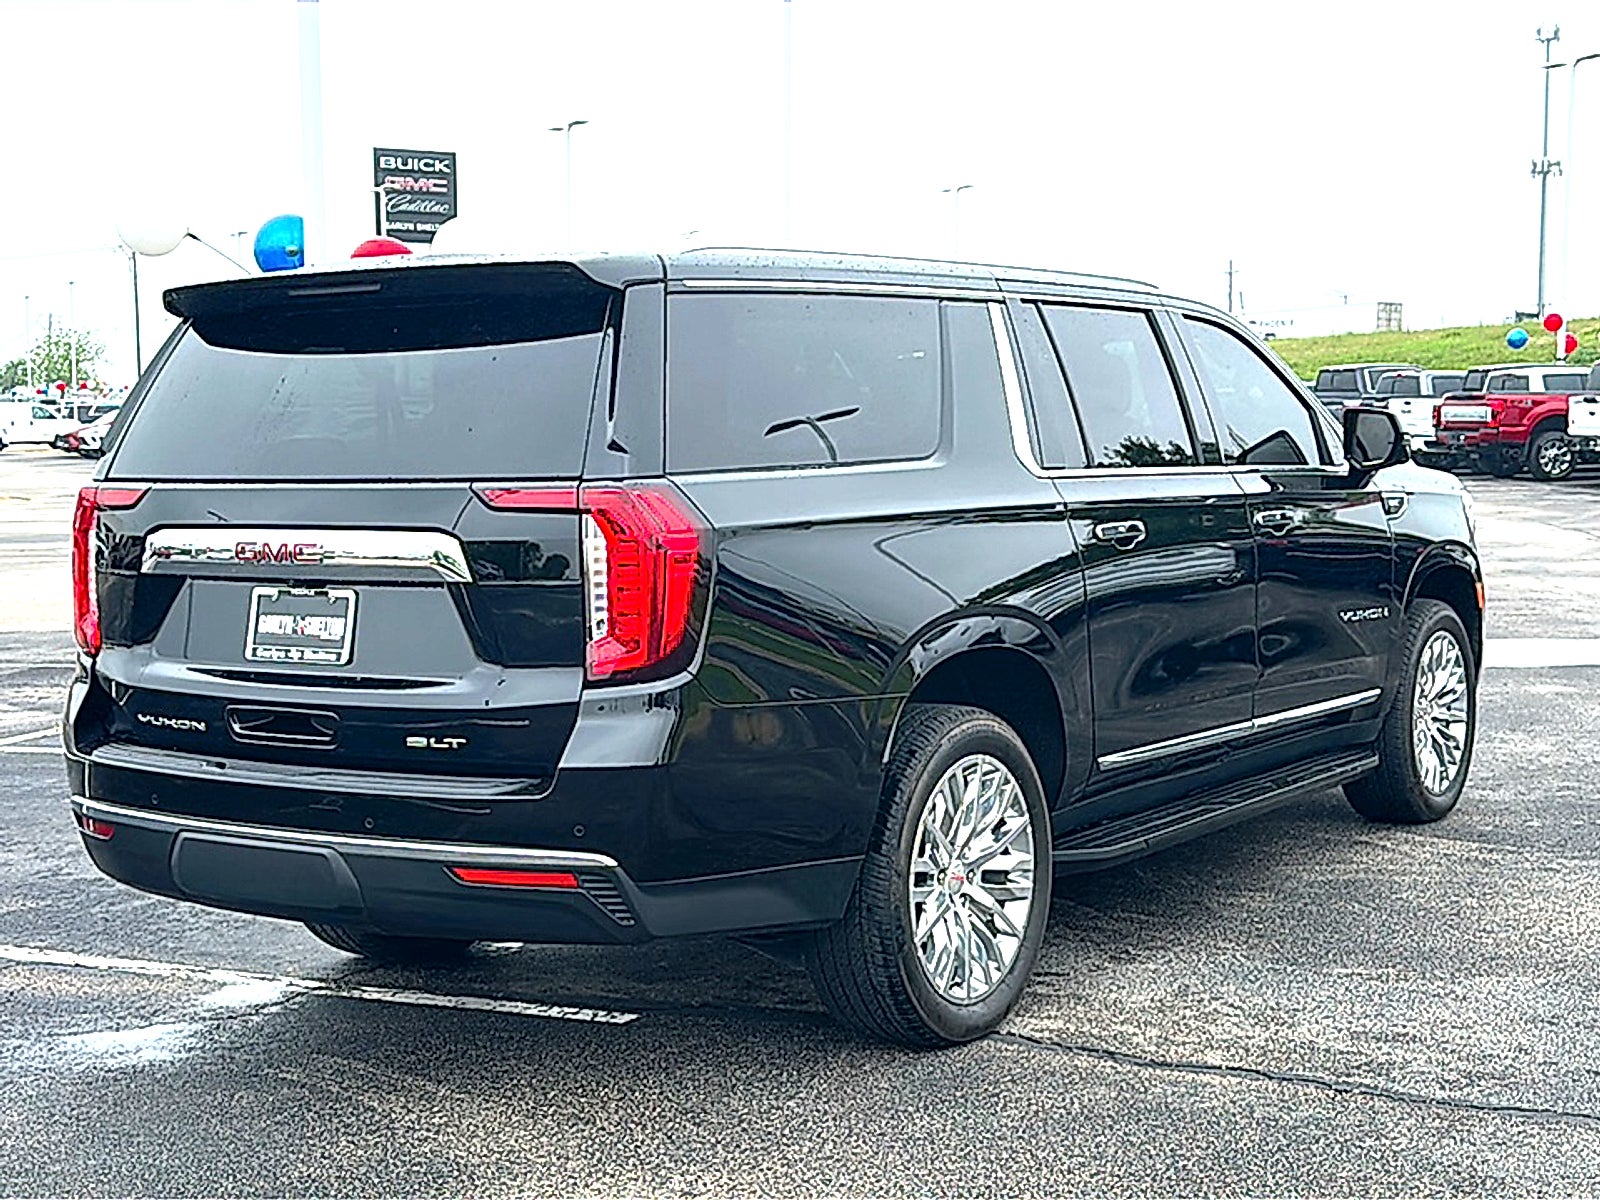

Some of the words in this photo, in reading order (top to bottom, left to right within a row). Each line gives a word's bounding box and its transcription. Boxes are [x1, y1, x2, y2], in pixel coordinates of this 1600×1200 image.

[379, 156, 451, 173] BUICK
[383, 176, 448, 192] GMC
[386, 193, 449, 214] Cadillac
[235, 542, 320, 562] GMC
[137, 713, 206, 731] YUKON
[406, 736, 467, 749] SLT
